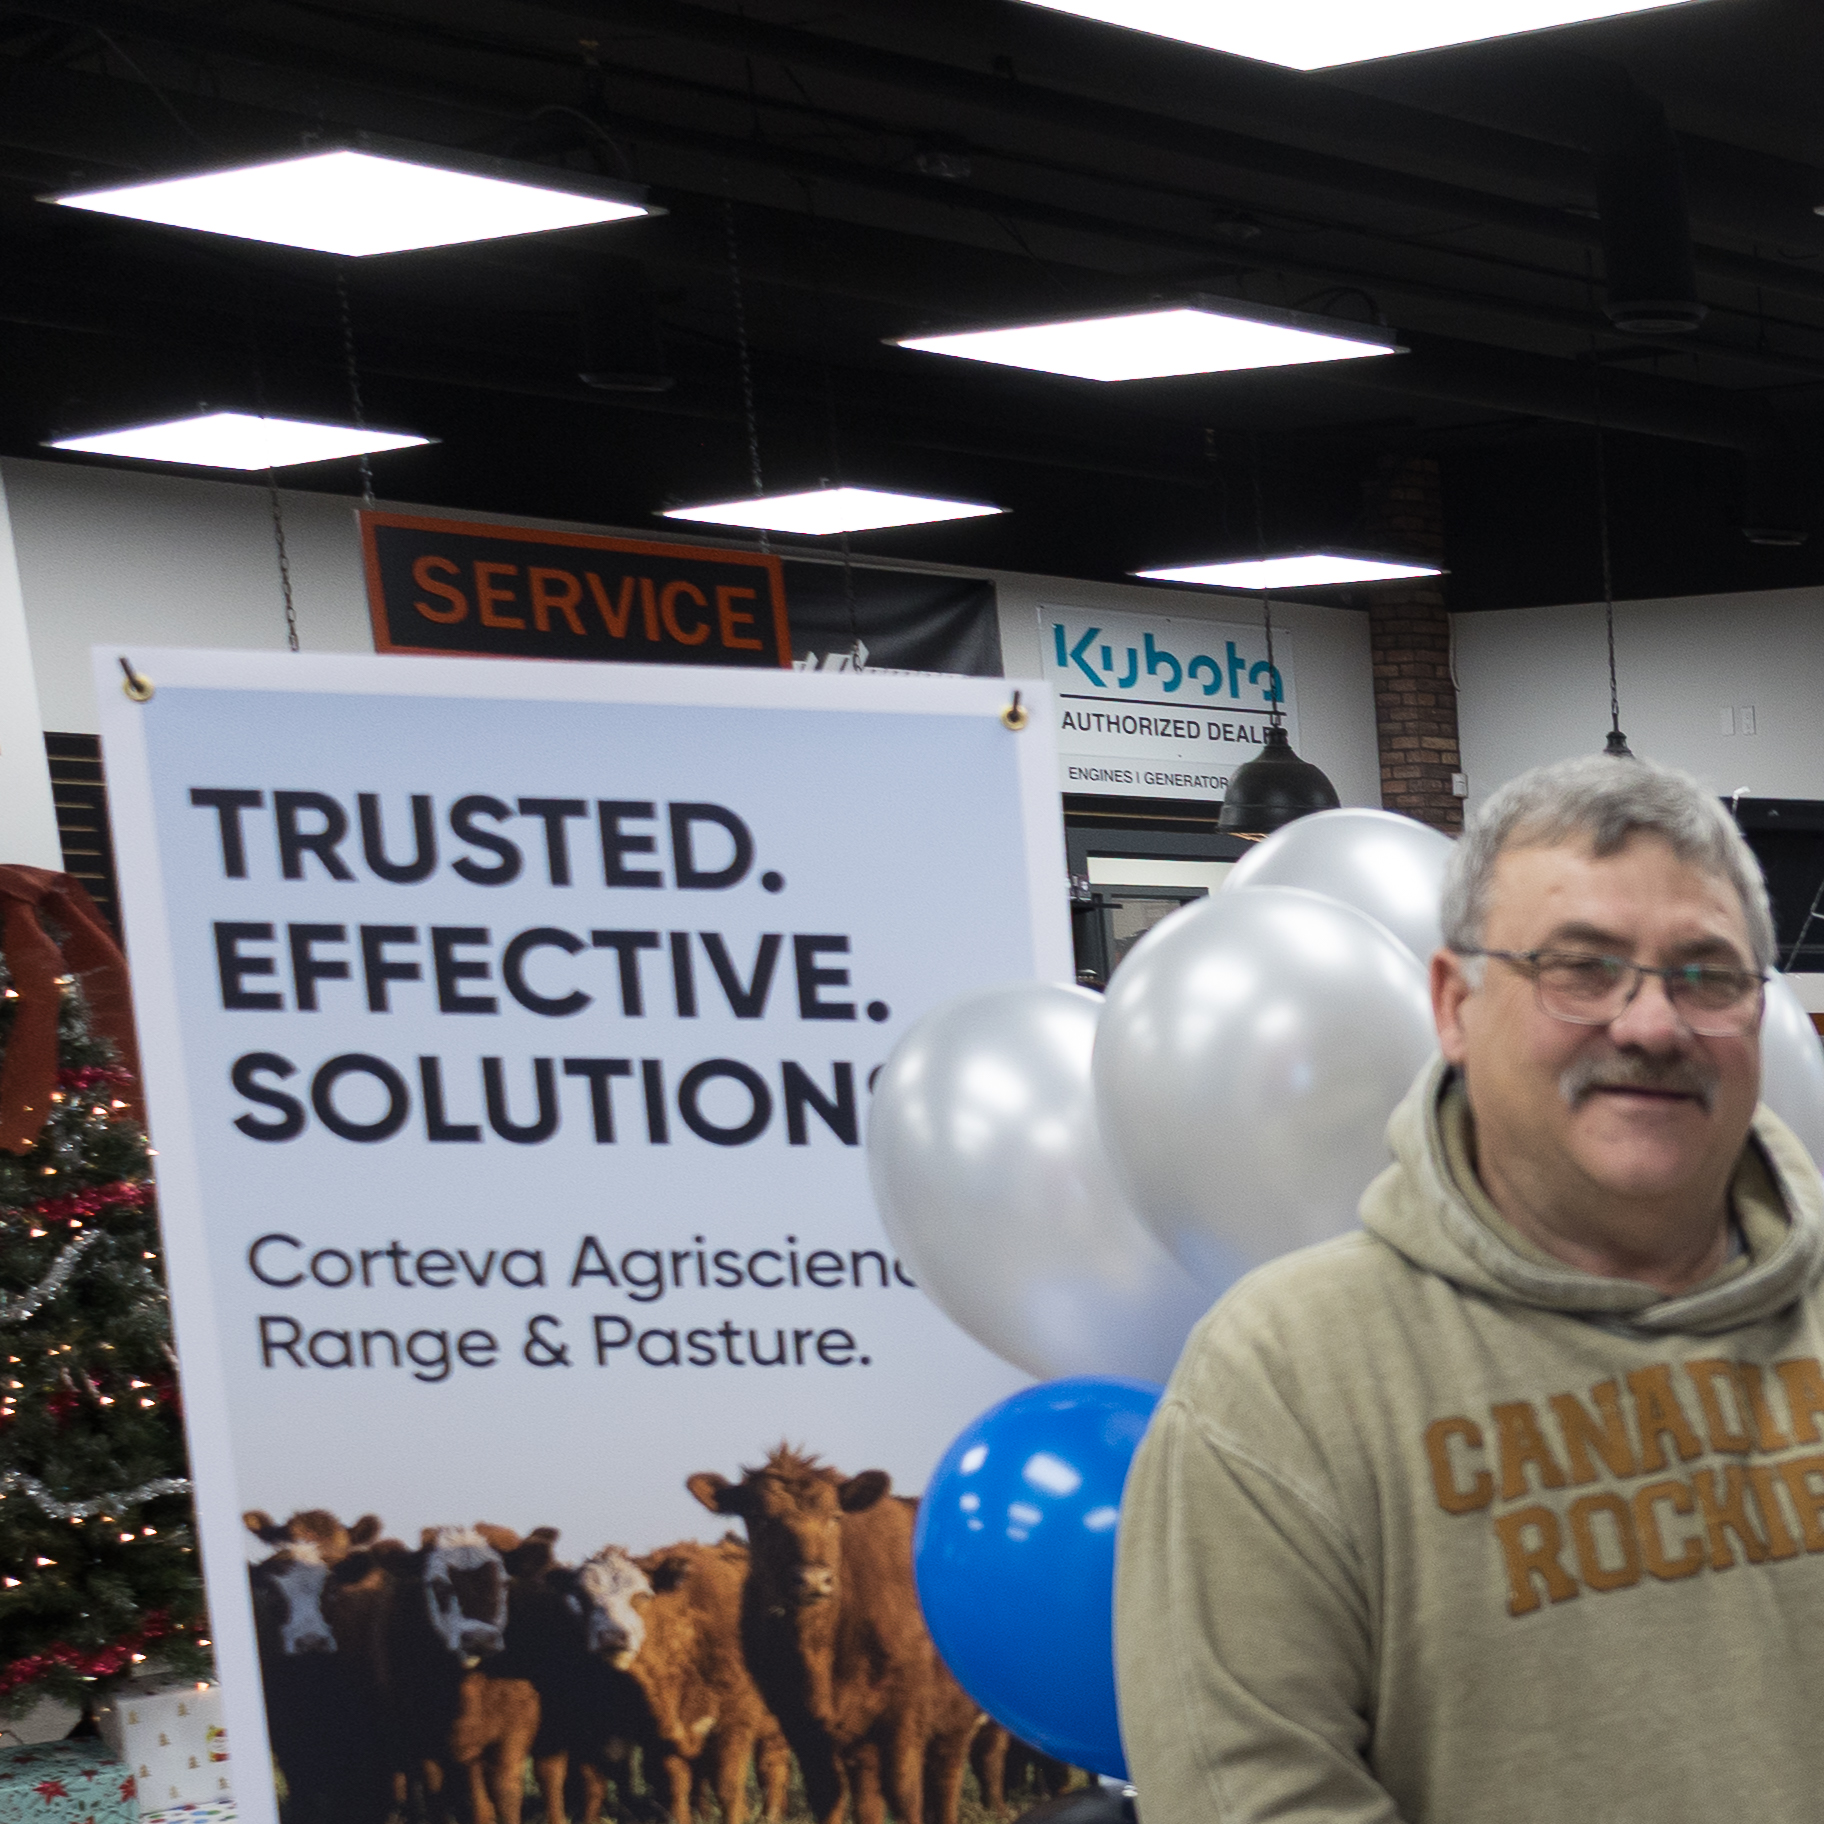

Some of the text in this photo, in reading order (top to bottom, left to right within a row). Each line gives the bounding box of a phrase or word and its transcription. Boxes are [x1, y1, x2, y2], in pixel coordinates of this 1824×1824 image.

[412, 554, 763, 650] SERVICE
[1052, 623, 1285, 703] Kubota
[1061, 710, 1201, 740] AUTHORIZED
[1068, 766, 1133, 784] ENGINES
[1144, 771, 1229, 790] GENERATOR
[190, 787, 786, 893] TRUSTED.
[213, 921, 890, 1023] EFFECTIVE.
[229, 1050, 886, 1146] SOLUTION
[247, 1233, 918, 1303] Corteva Agriscienc
[257, 1314, 872, 1384] Range & Pasture.
